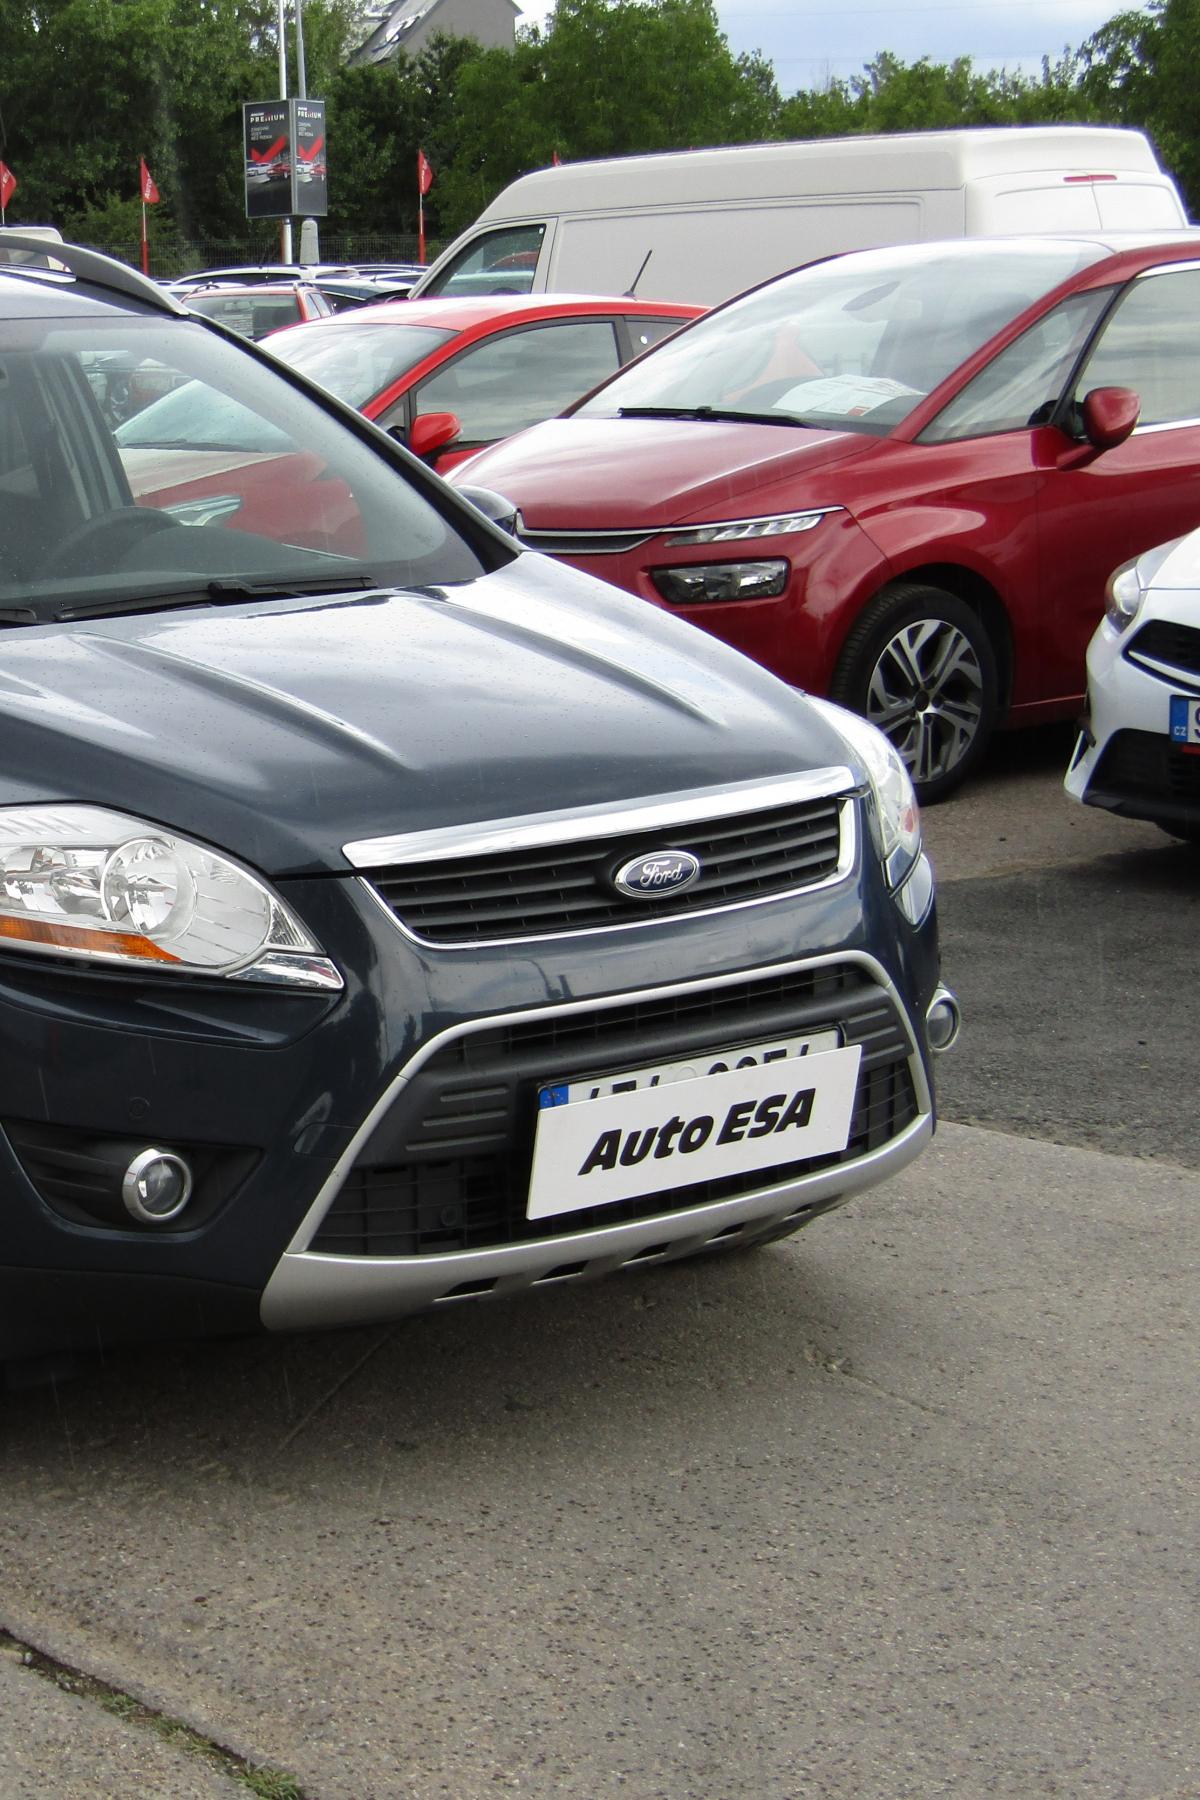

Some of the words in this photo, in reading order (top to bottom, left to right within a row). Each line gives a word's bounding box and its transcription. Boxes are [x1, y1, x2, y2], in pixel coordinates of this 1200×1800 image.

[1173, 725, 1187, 736] CZ
[639, 859, 683, 888] Ford
[577, 1115, 714, 1176] Auto
[716, 1087, 816, 1146] ESA
